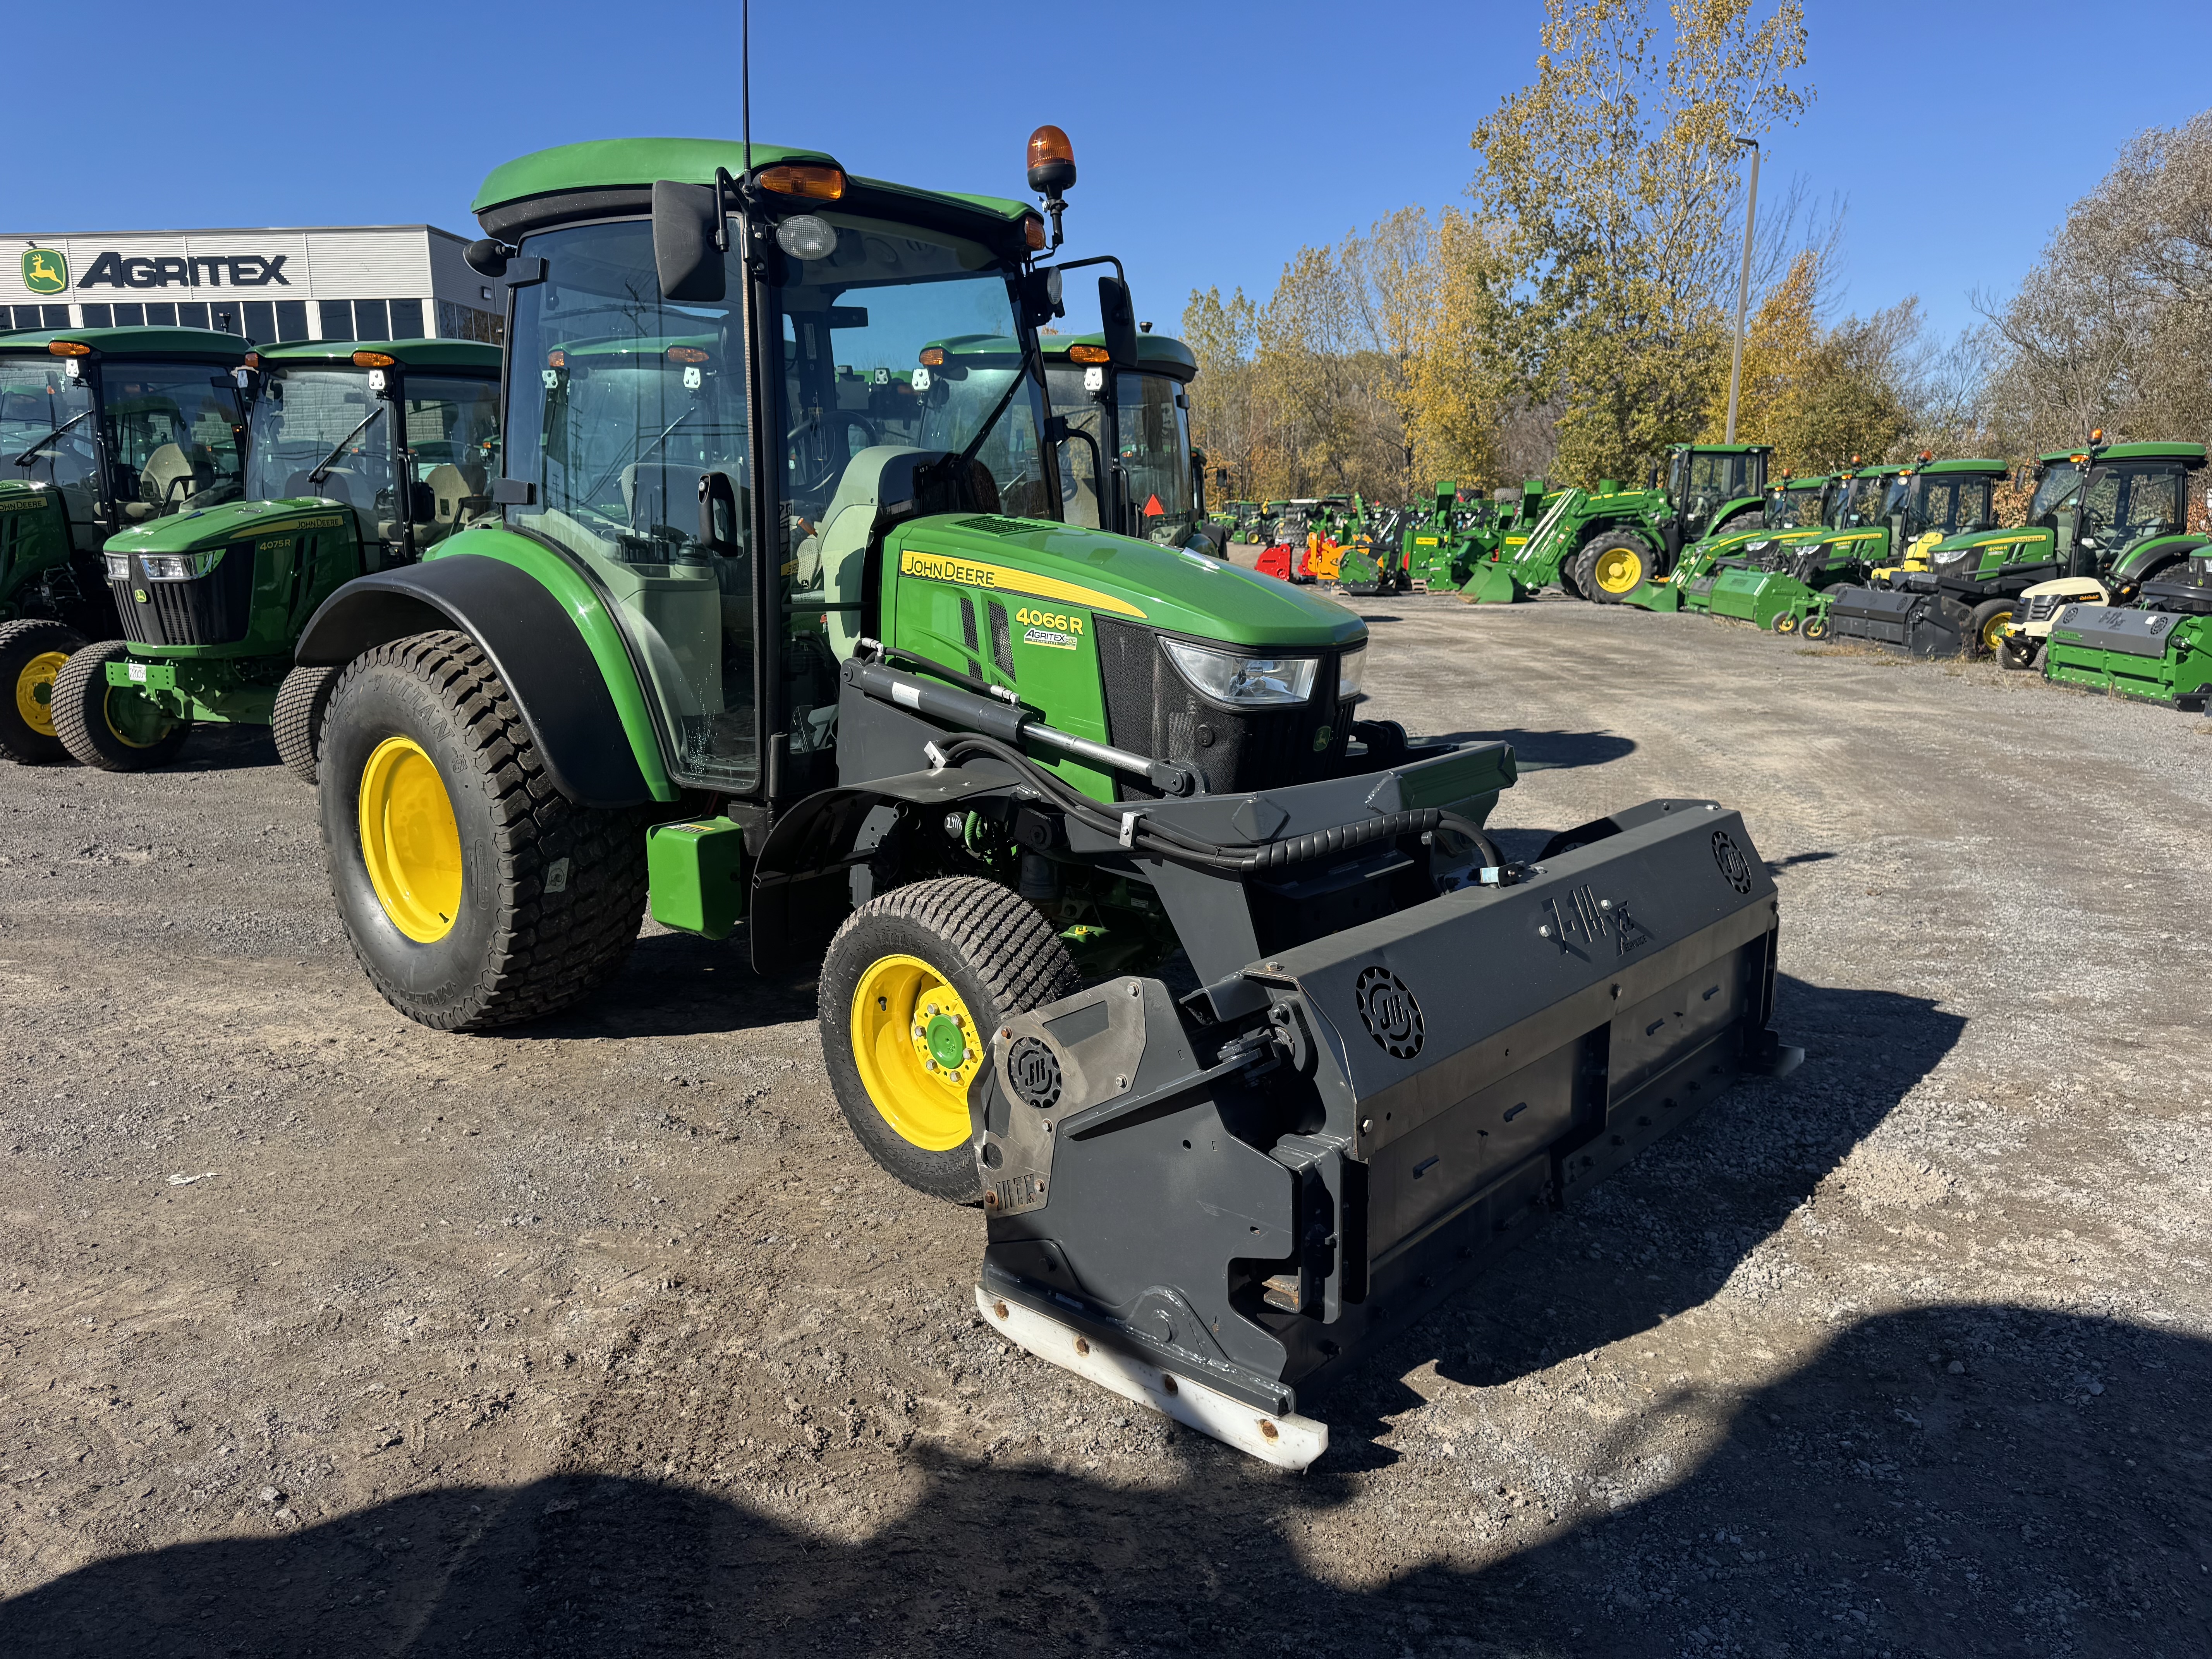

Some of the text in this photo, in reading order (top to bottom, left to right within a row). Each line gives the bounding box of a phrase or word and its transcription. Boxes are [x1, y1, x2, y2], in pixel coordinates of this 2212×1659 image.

[76, 251, 292, 288] AGRITEX
[16, 501, 42, 509] DEERE
[297, 519, 338, 529] JOHN DEERE
[906, 556, 995, 586] JOHN DEERE
[1025, 629, 1065, 642] AGRITEX
[386, 673, 455, 742] TITAN
[400, 979, 455, 1007] MULTI
[1379, 994, 1404, 1030] JR
[1025, 1058, 1046, 1087] JR
